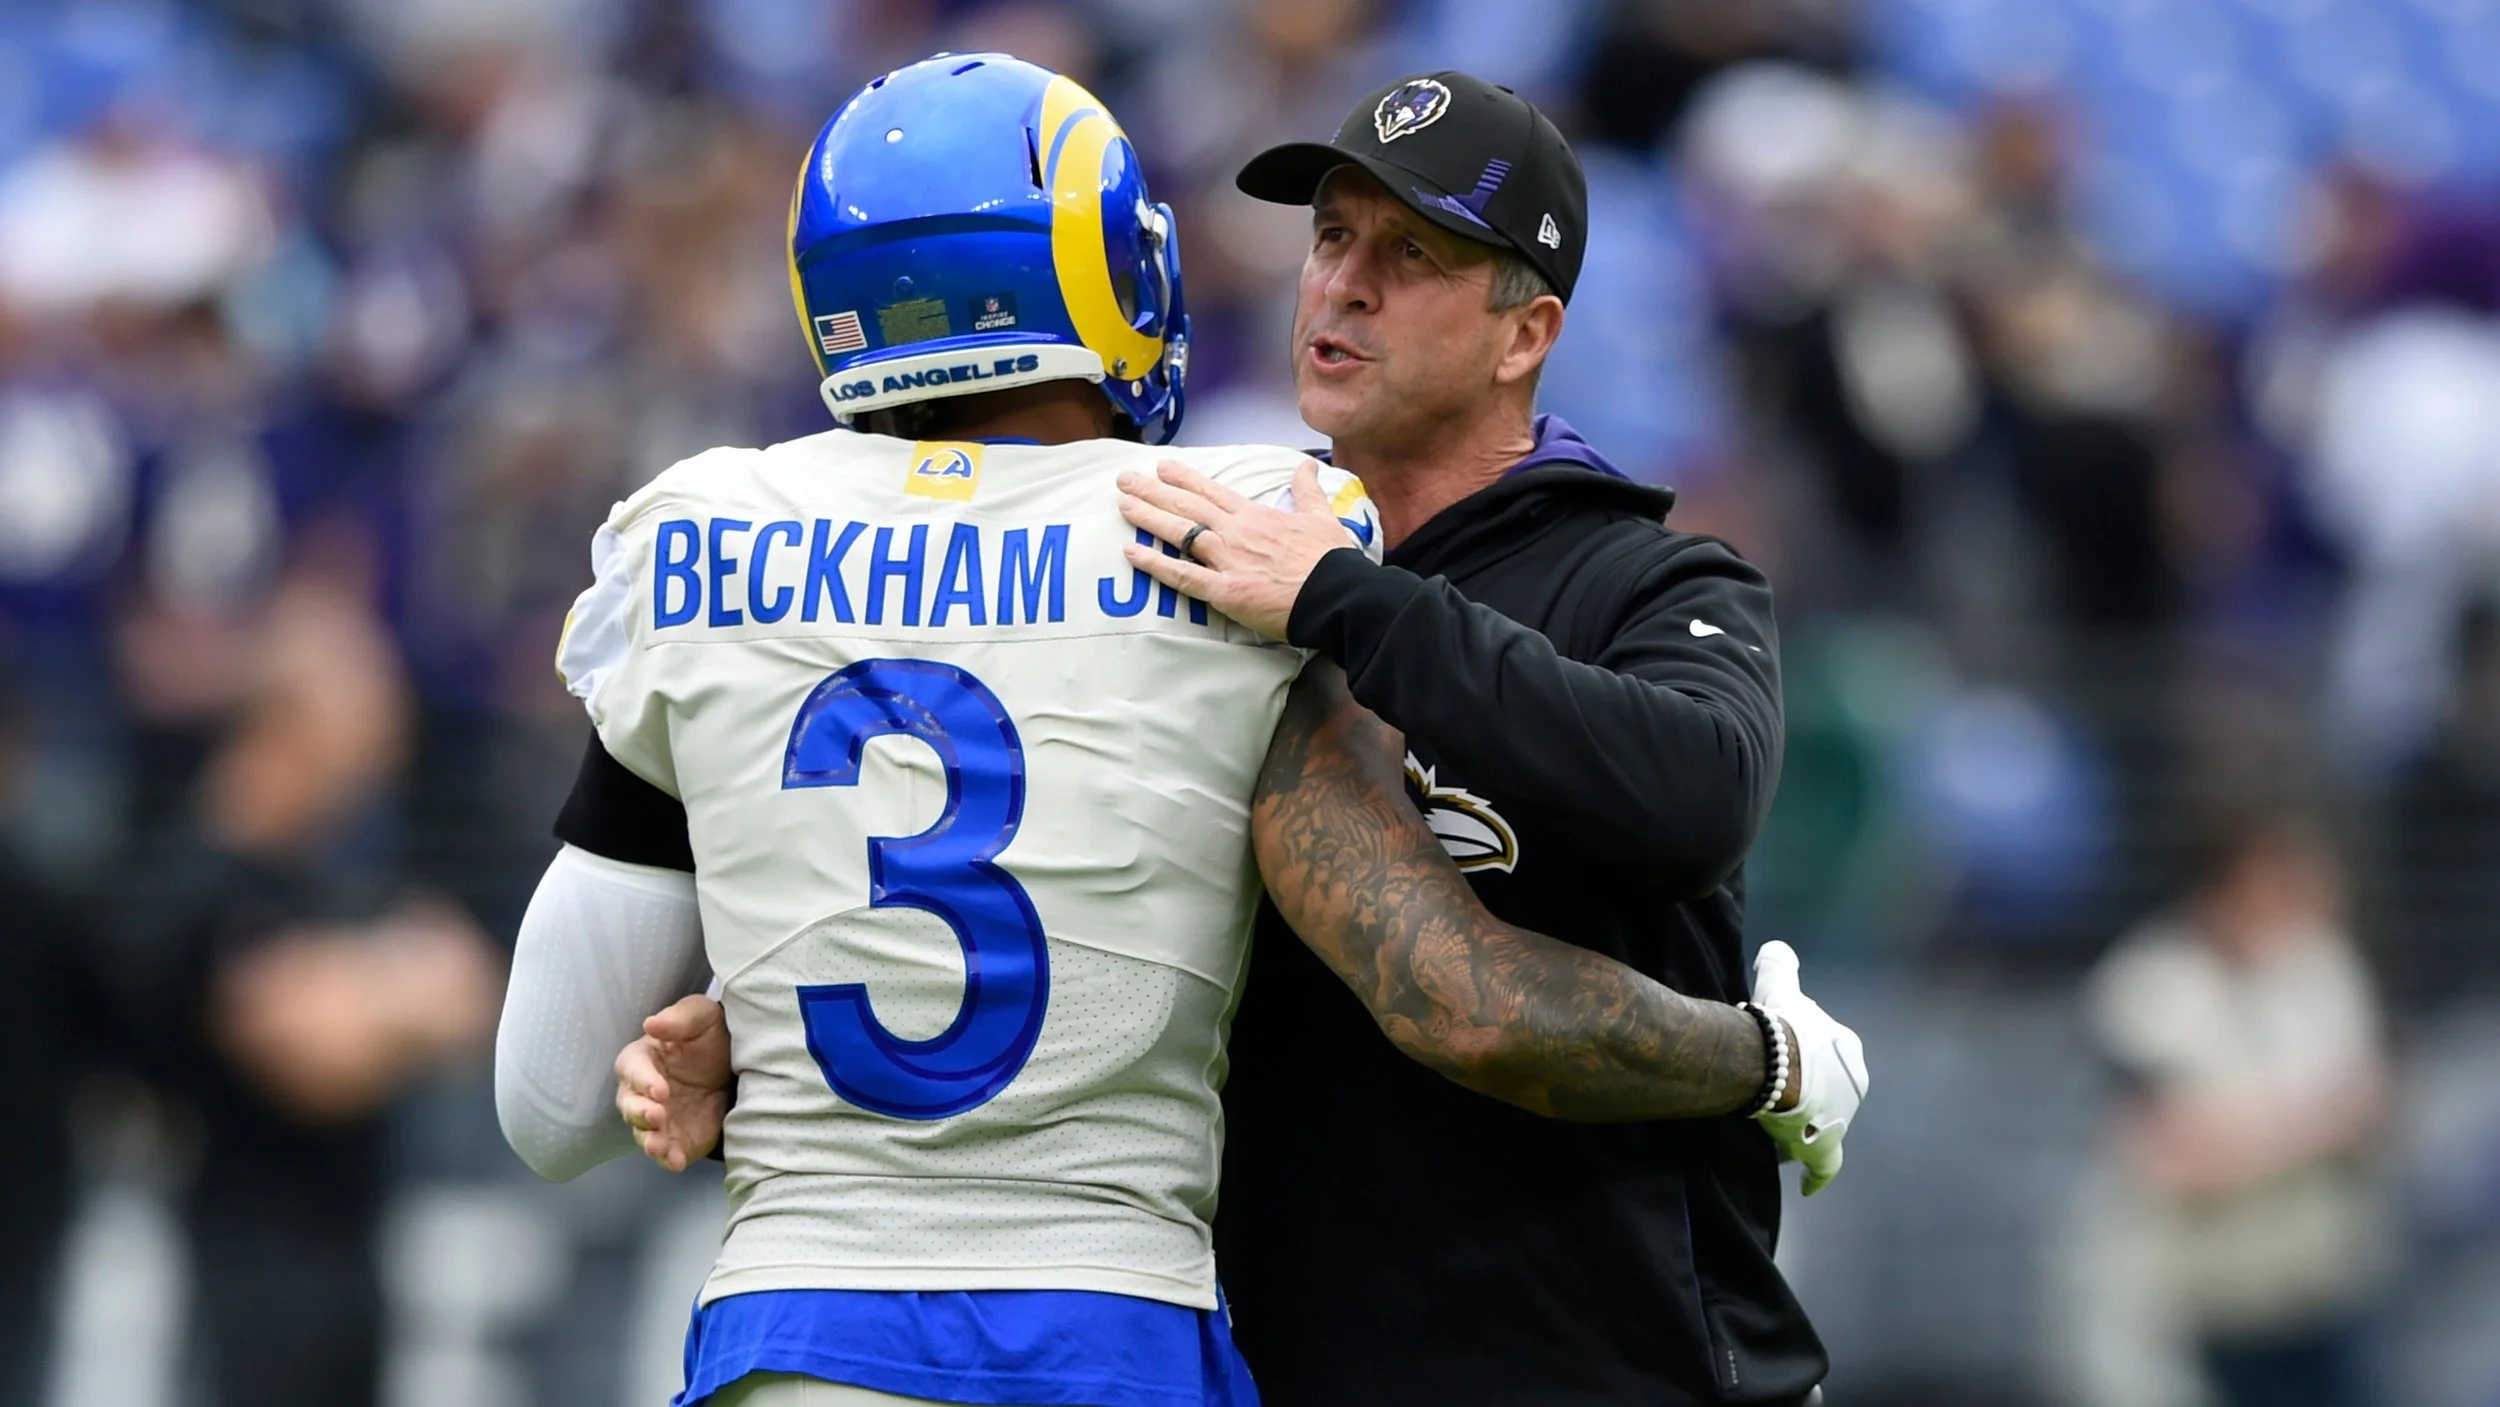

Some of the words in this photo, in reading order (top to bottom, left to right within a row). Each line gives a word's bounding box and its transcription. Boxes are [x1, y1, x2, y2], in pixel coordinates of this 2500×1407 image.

[829, 381, 876, 402] LOS
[883, 355, 1039, 393] ANGELES
[914, 449, 973, 480] LA
[653, 517, 1071, 630] BECKHAM
[781, 658, 1051, 1120] 3
